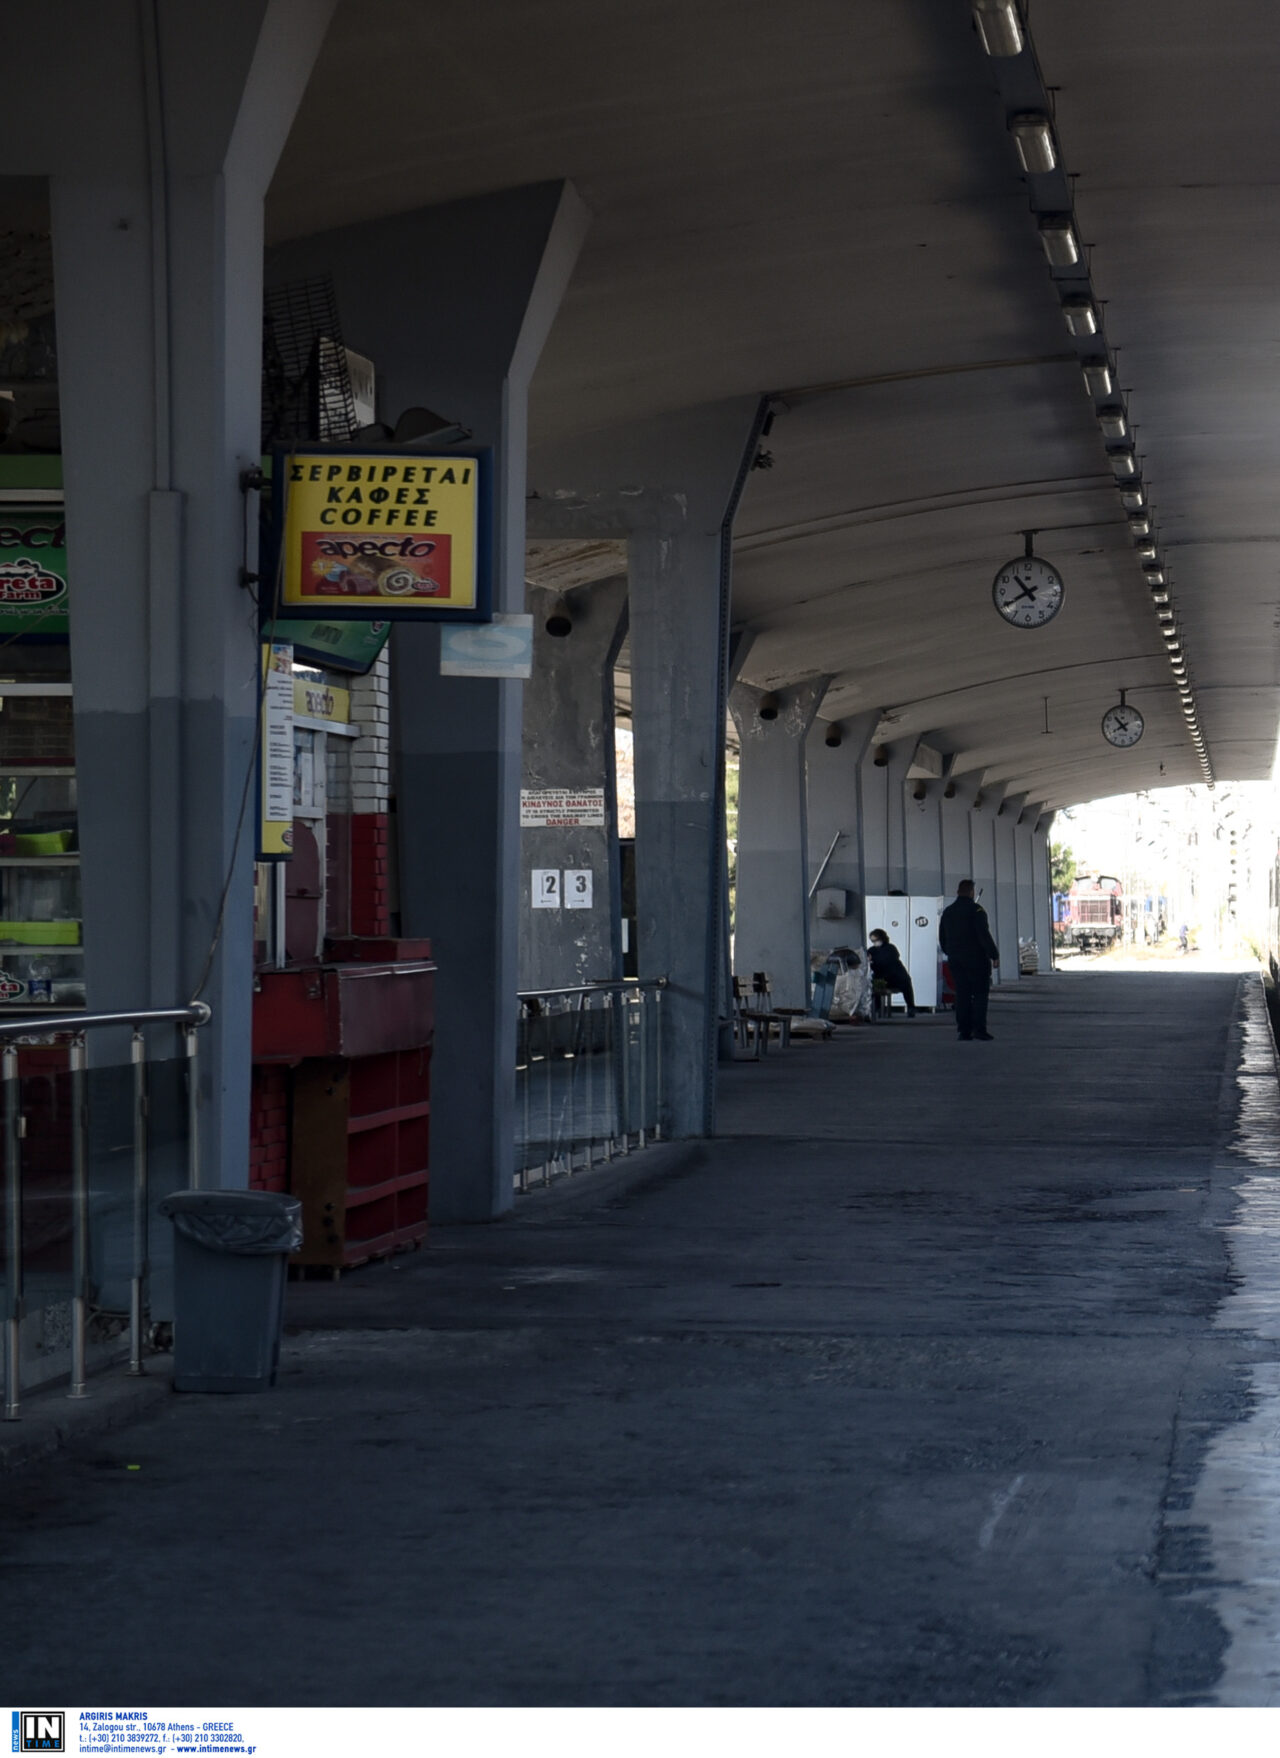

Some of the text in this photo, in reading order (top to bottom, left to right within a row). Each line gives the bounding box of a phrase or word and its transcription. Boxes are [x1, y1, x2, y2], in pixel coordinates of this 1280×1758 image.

[290, 464, 470, 484] ΣΕΡΒΙΡΕΤΑΙ
[327, 486, 430, 504] ΚΑΦΕΣ
[320, 508, 438, 527] COFFEE
[546, 876, 556, 894] 2
[576, 875, 587, 893] 3
